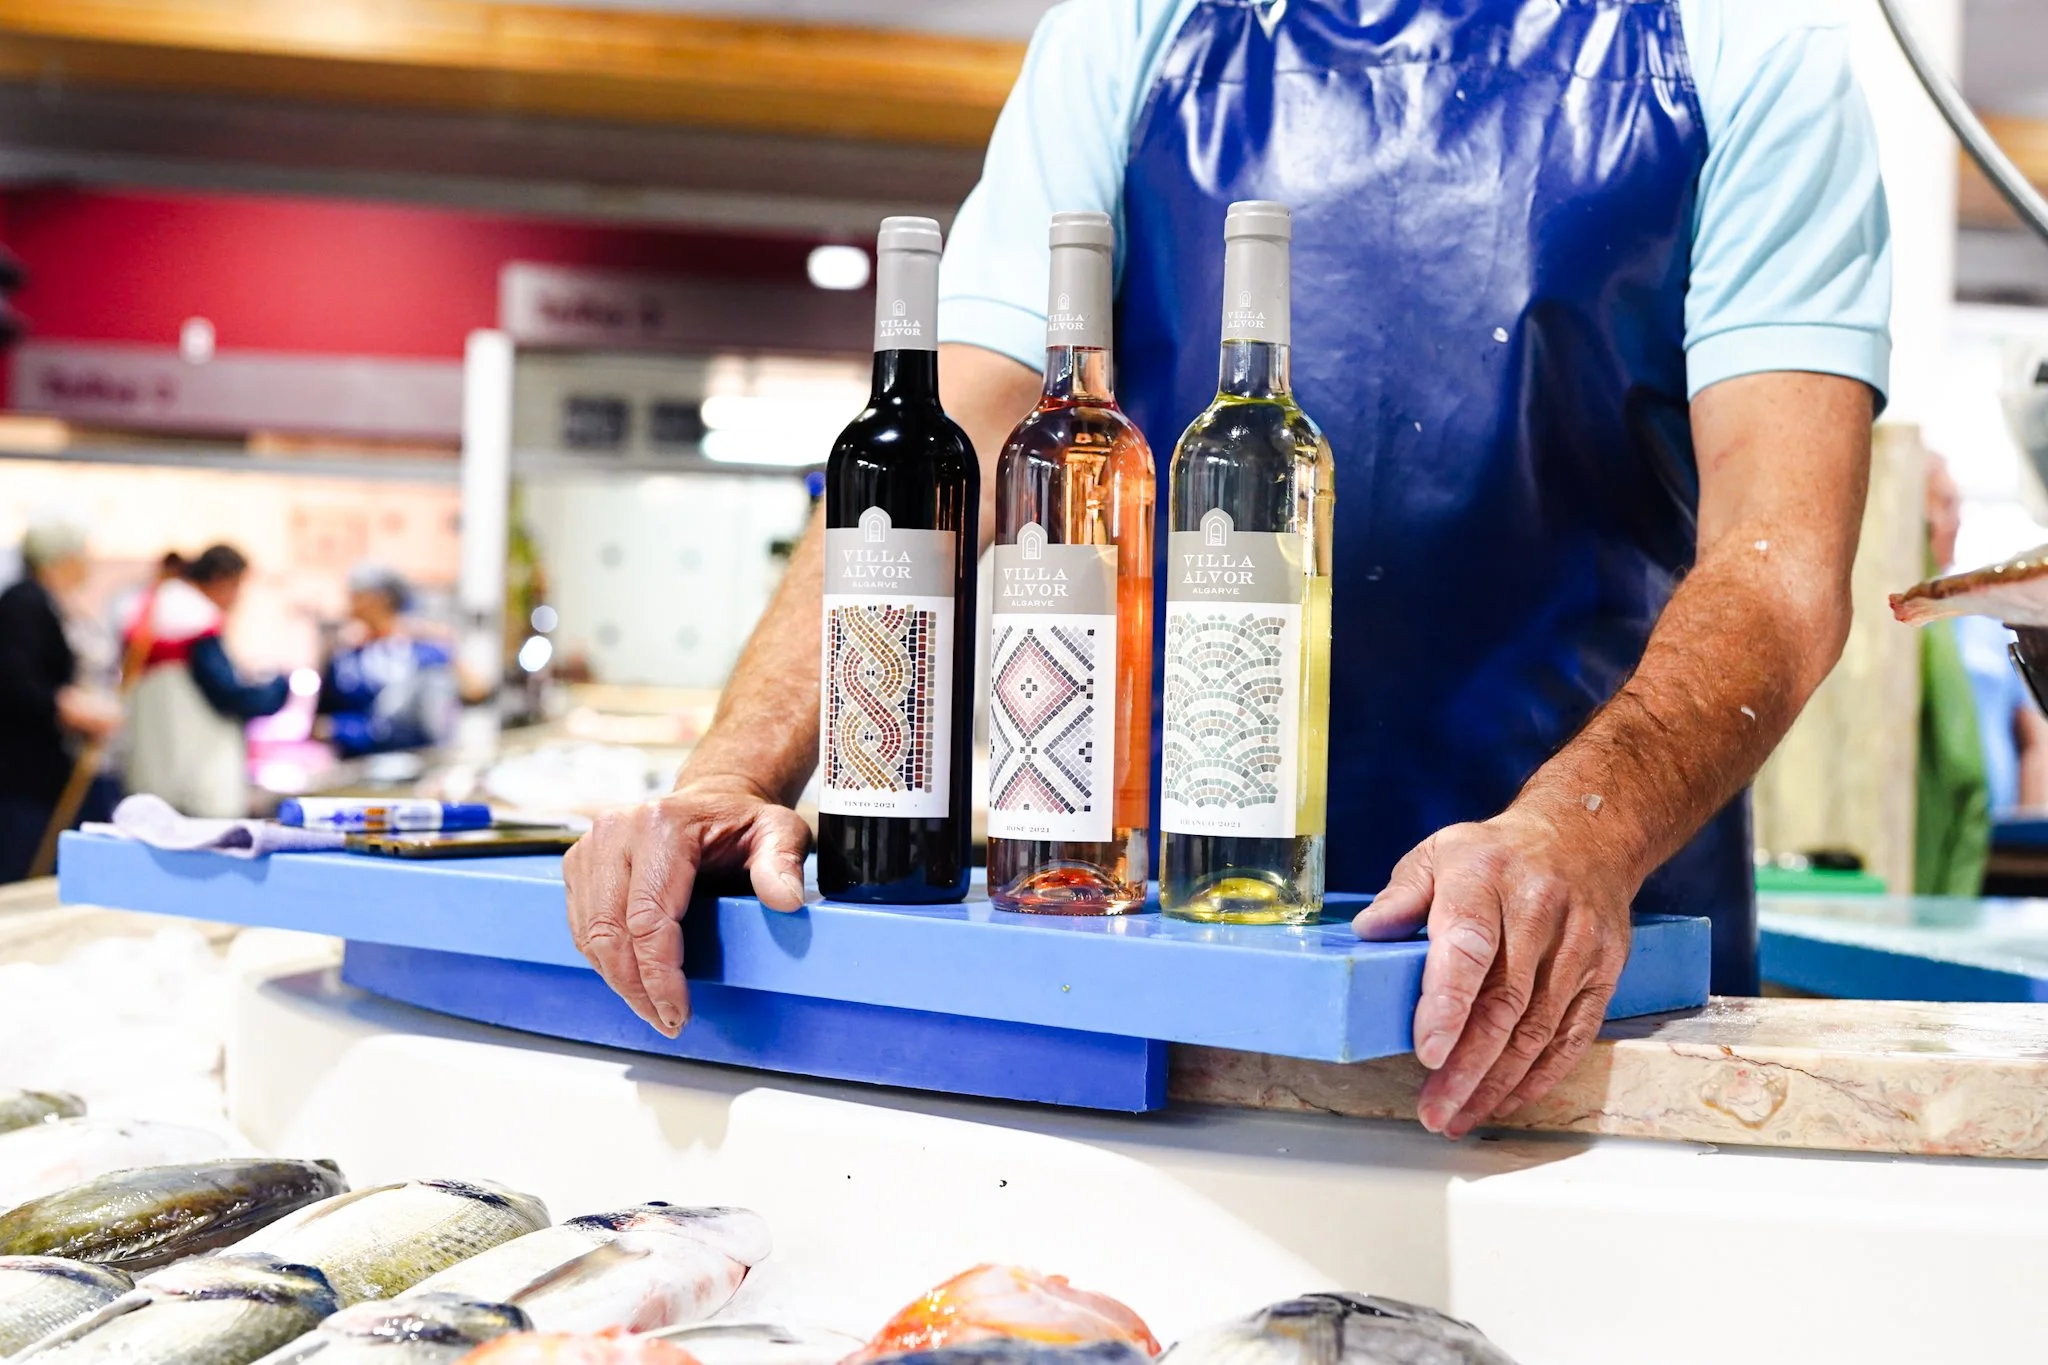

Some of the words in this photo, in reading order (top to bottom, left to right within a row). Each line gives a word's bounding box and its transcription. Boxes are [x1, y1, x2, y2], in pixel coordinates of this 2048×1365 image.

[1227, 311, 1266, 320] VILLA
[880, 319, 921, 328] VILLA
[1227, 320, 1265, 329] ALVOR
[880, 327, 921, 337] ALVOR
[842, 549, 912, 563] VILLA
[1183, 554, 1255, 568] VILLA
[842, 565, 912, 579] ALVOR
[1003, 567, 1069, 581] VILLA
[1182, 570, 1255, 584] ALVOR
[852, 581, 898, 589] ALGARVE
[1003, 583, 1069, 597] ALVOR
[1192, 587, 1240, 595] ALGARVE
[1011, 599, 1055, 607] ALGARVE
[844, 800, 871, 808] TINTO
